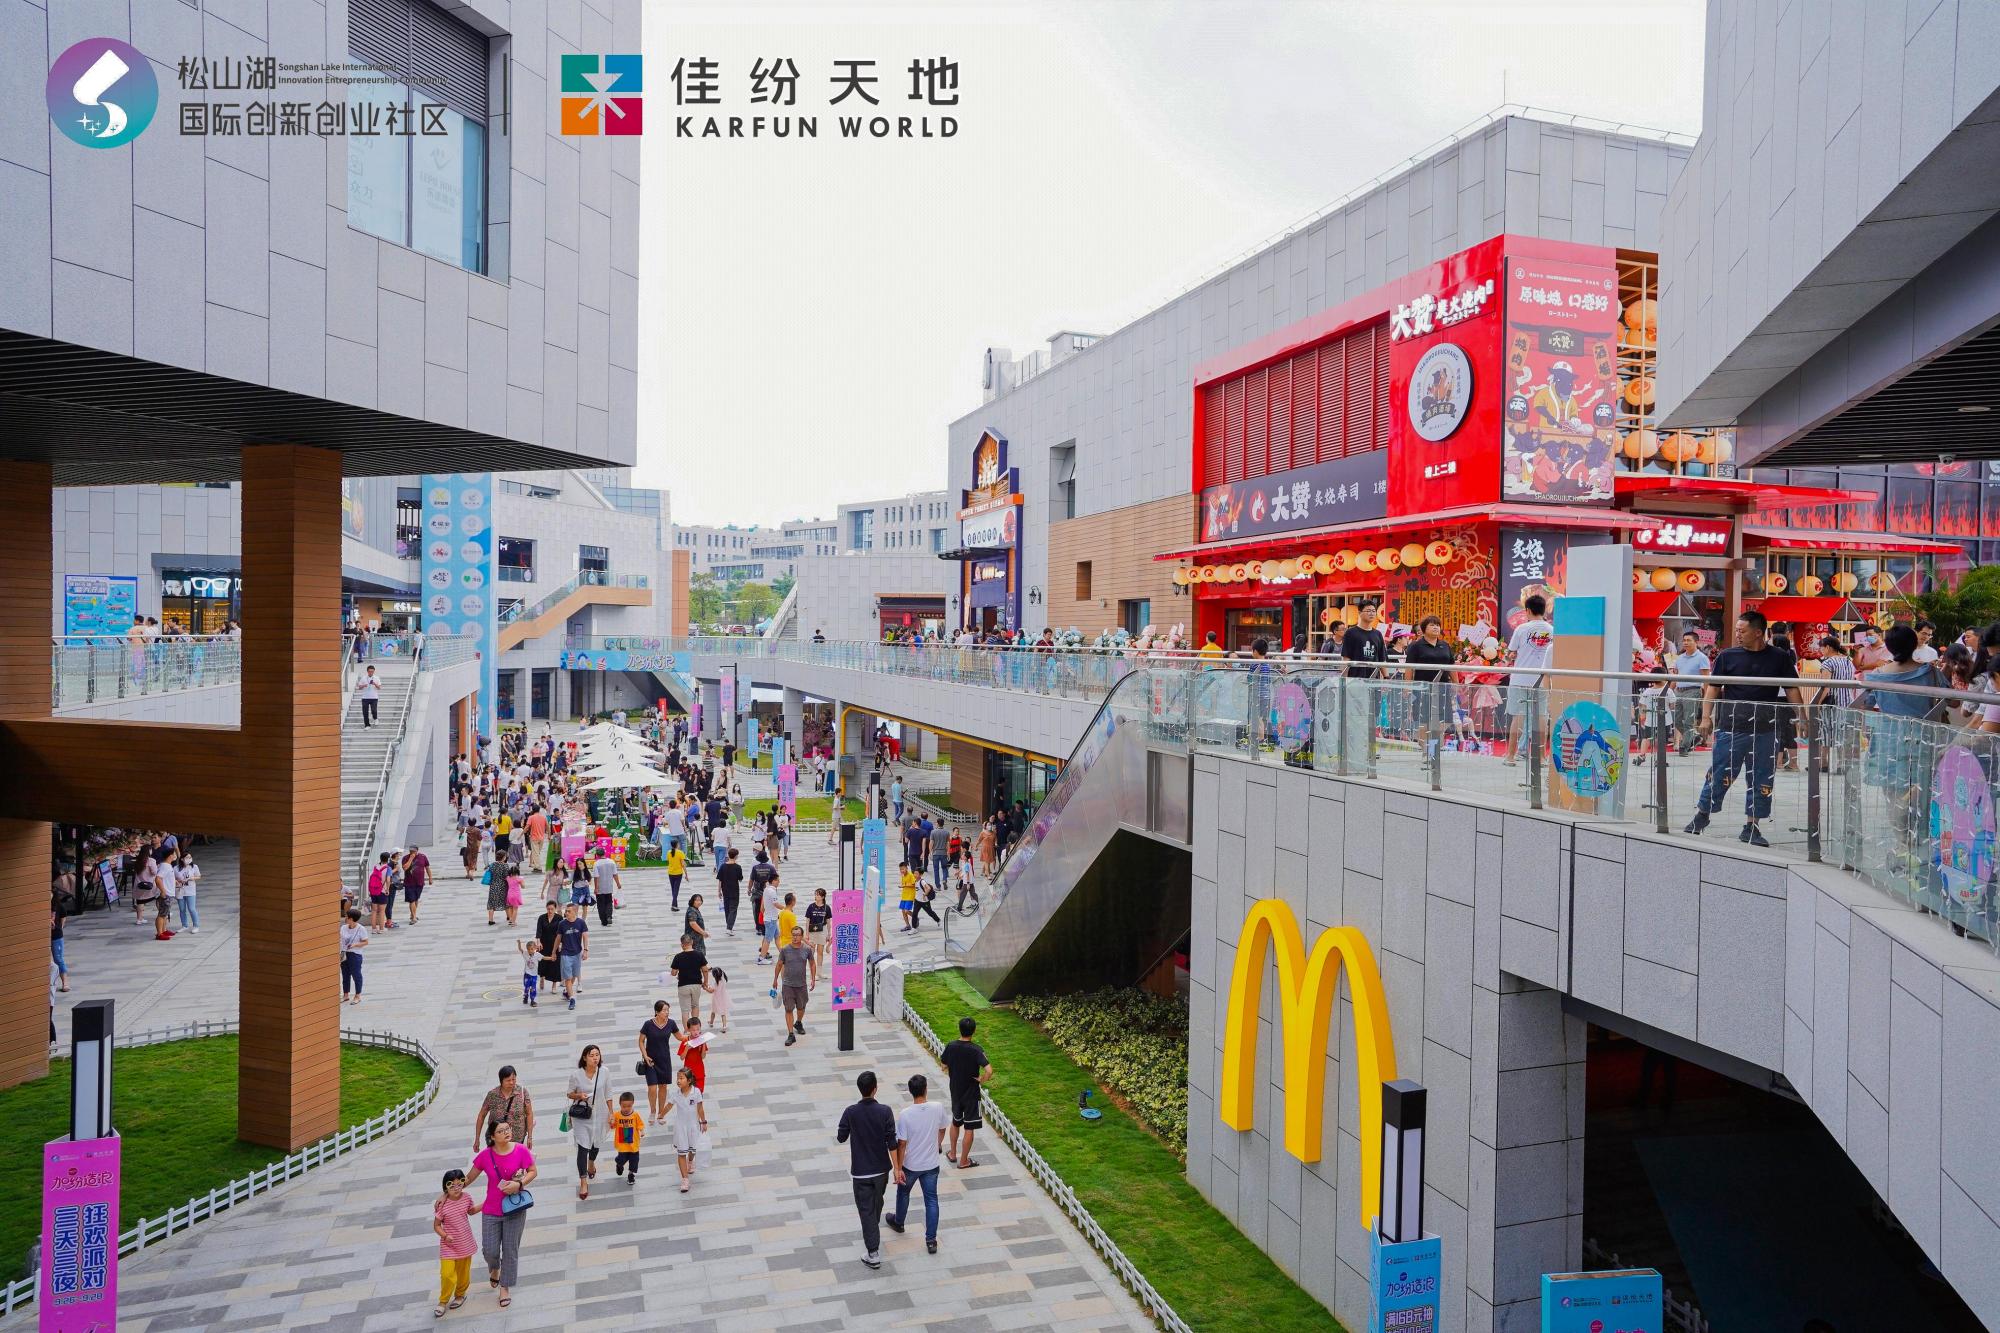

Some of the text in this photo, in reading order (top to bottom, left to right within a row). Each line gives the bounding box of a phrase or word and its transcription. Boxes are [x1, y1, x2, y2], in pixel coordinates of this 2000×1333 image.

[1271, 481, 1312, 522] 大赞
[1314, 482, 1359, 507] 炙烧寿司
[1512, 538, 1545, 560] 炙烧
[1509, 560, 1545, 580] 三宝
[53, 1206, 79, 1294] 三天三夜
[82, 1202, 108, 1291] 狂欢派对
